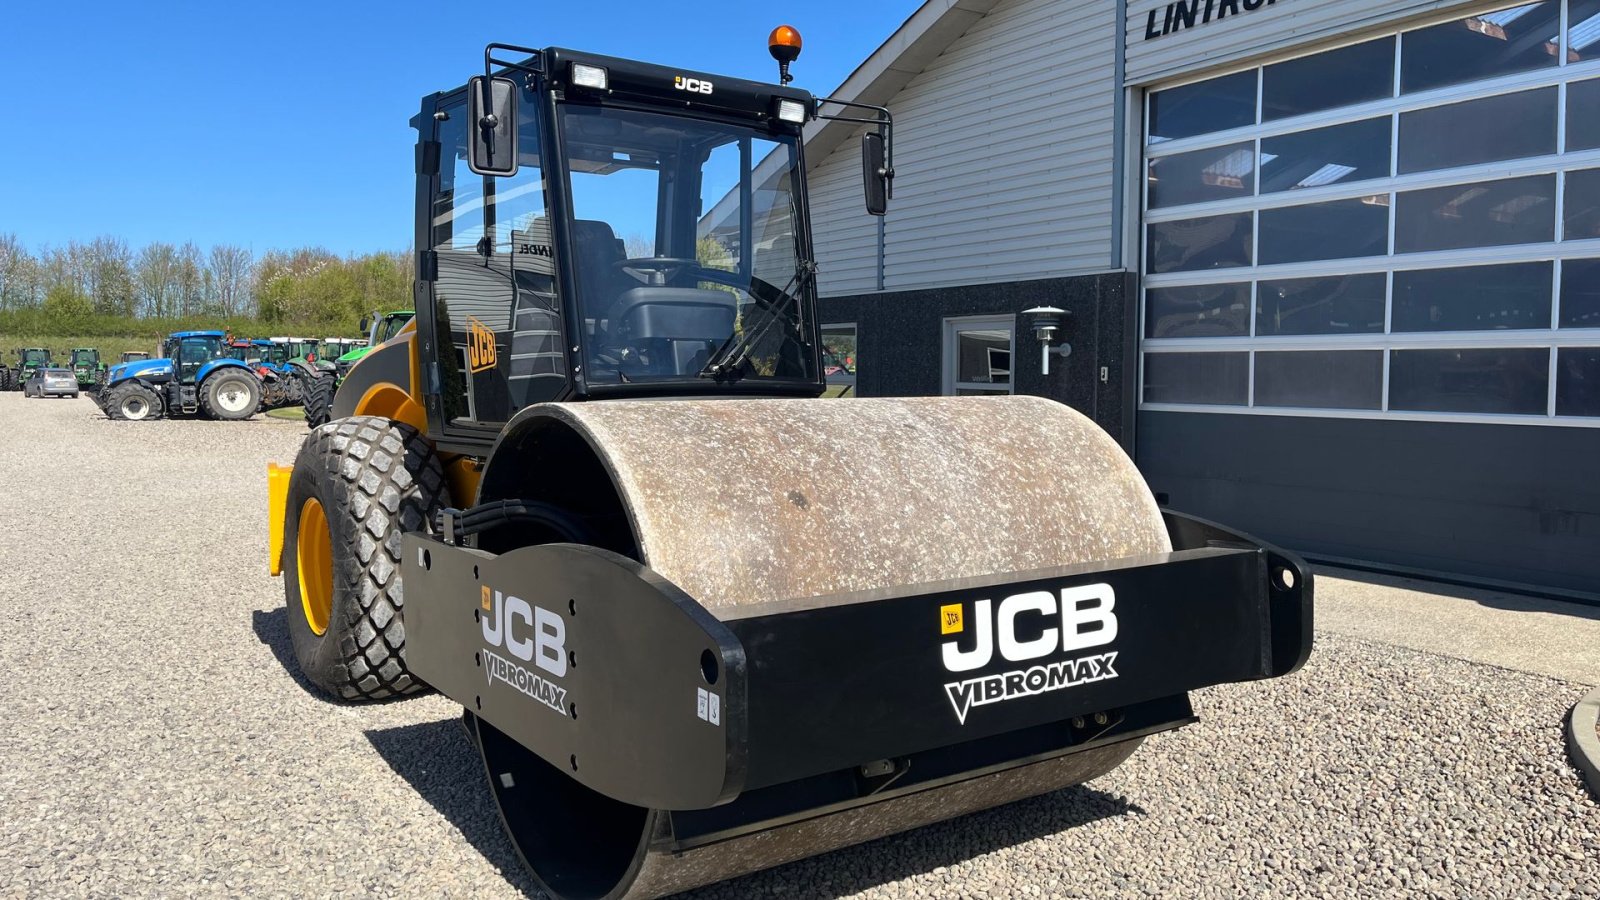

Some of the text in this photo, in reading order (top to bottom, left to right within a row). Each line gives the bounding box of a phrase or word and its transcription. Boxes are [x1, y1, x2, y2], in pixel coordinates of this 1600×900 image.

[675, 77, 713, 95] JCB
[470, 322, 495, 367] JCB
[482, 590, 567, 678] JCB
[942, 583, 1118, 672] JCB
[483, 648, 567, 716] VIBROMAX
[944, 651, 1119, 725] VIBROMAX
